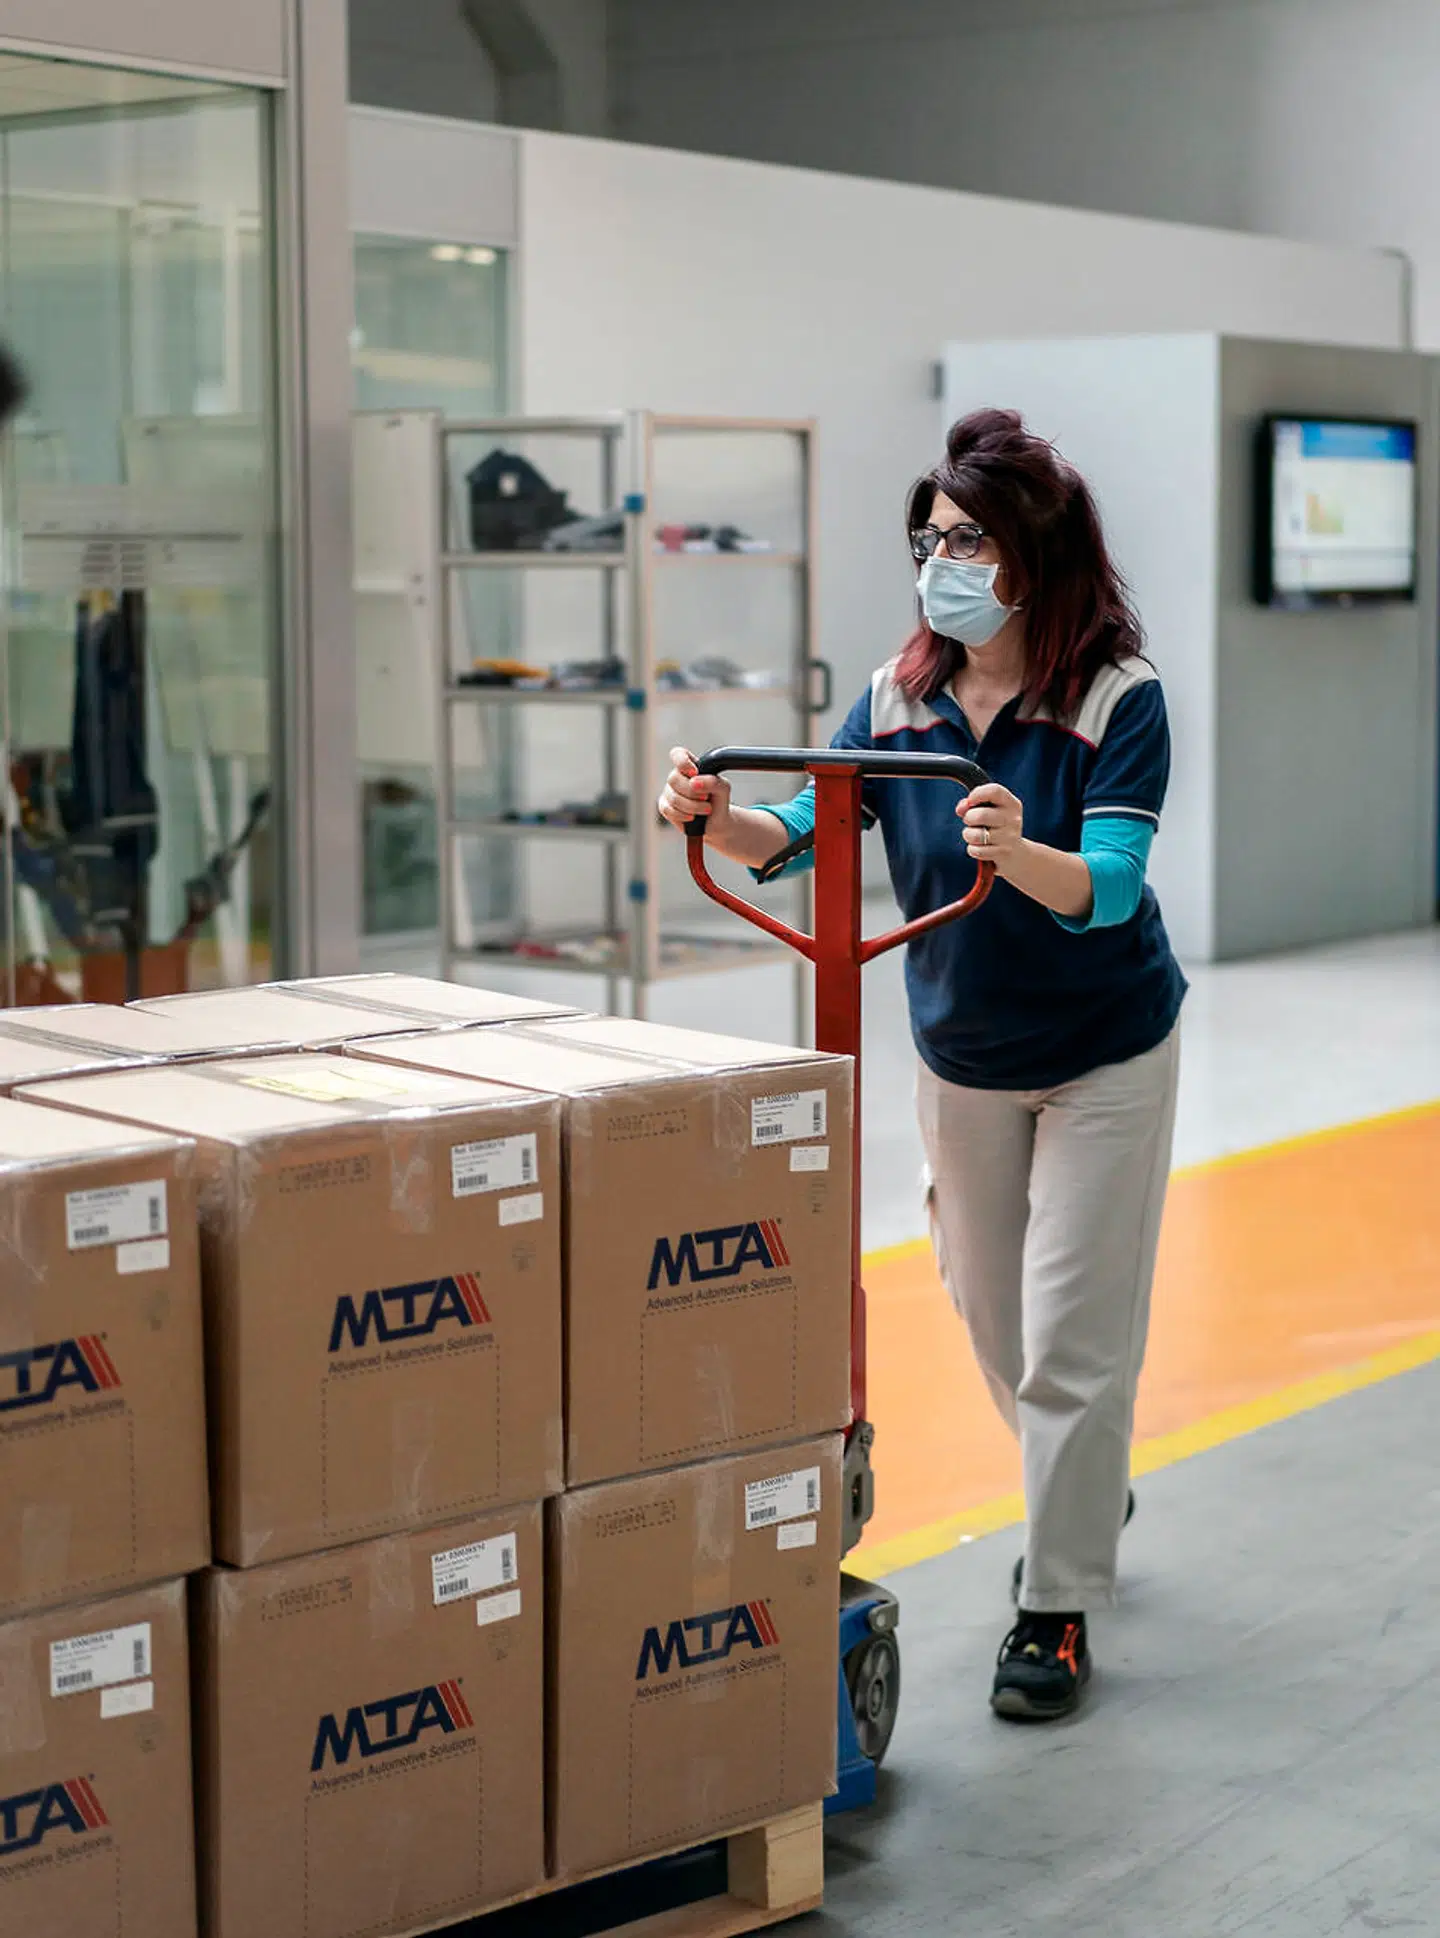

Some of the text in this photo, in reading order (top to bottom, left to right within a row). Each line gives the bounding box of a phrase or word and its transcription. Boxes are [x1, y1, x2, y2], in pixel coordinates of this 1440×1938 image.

[647, 1221, 775, 1290] MTA
[327, 1276, 473, 1353] MTA
[646, 1275, 792, 1311] Advanced Automotive Solutions
[0, 1338, 101, 1411] TA
[327, 1331, 494, 1374] Advanced Automotive Solutions
[70, 1398, 126, 1417] Solutions
[635, 1604, 763, 1681] MTA
[636, 1653, 782, 1698] Advanced Automotive Solutions
[311, 1684, 456, 1772] MTA
[311, 1735, 478, 1792] Advanced Automotive Solutions
[0, 1783, 87, 1855] TA
